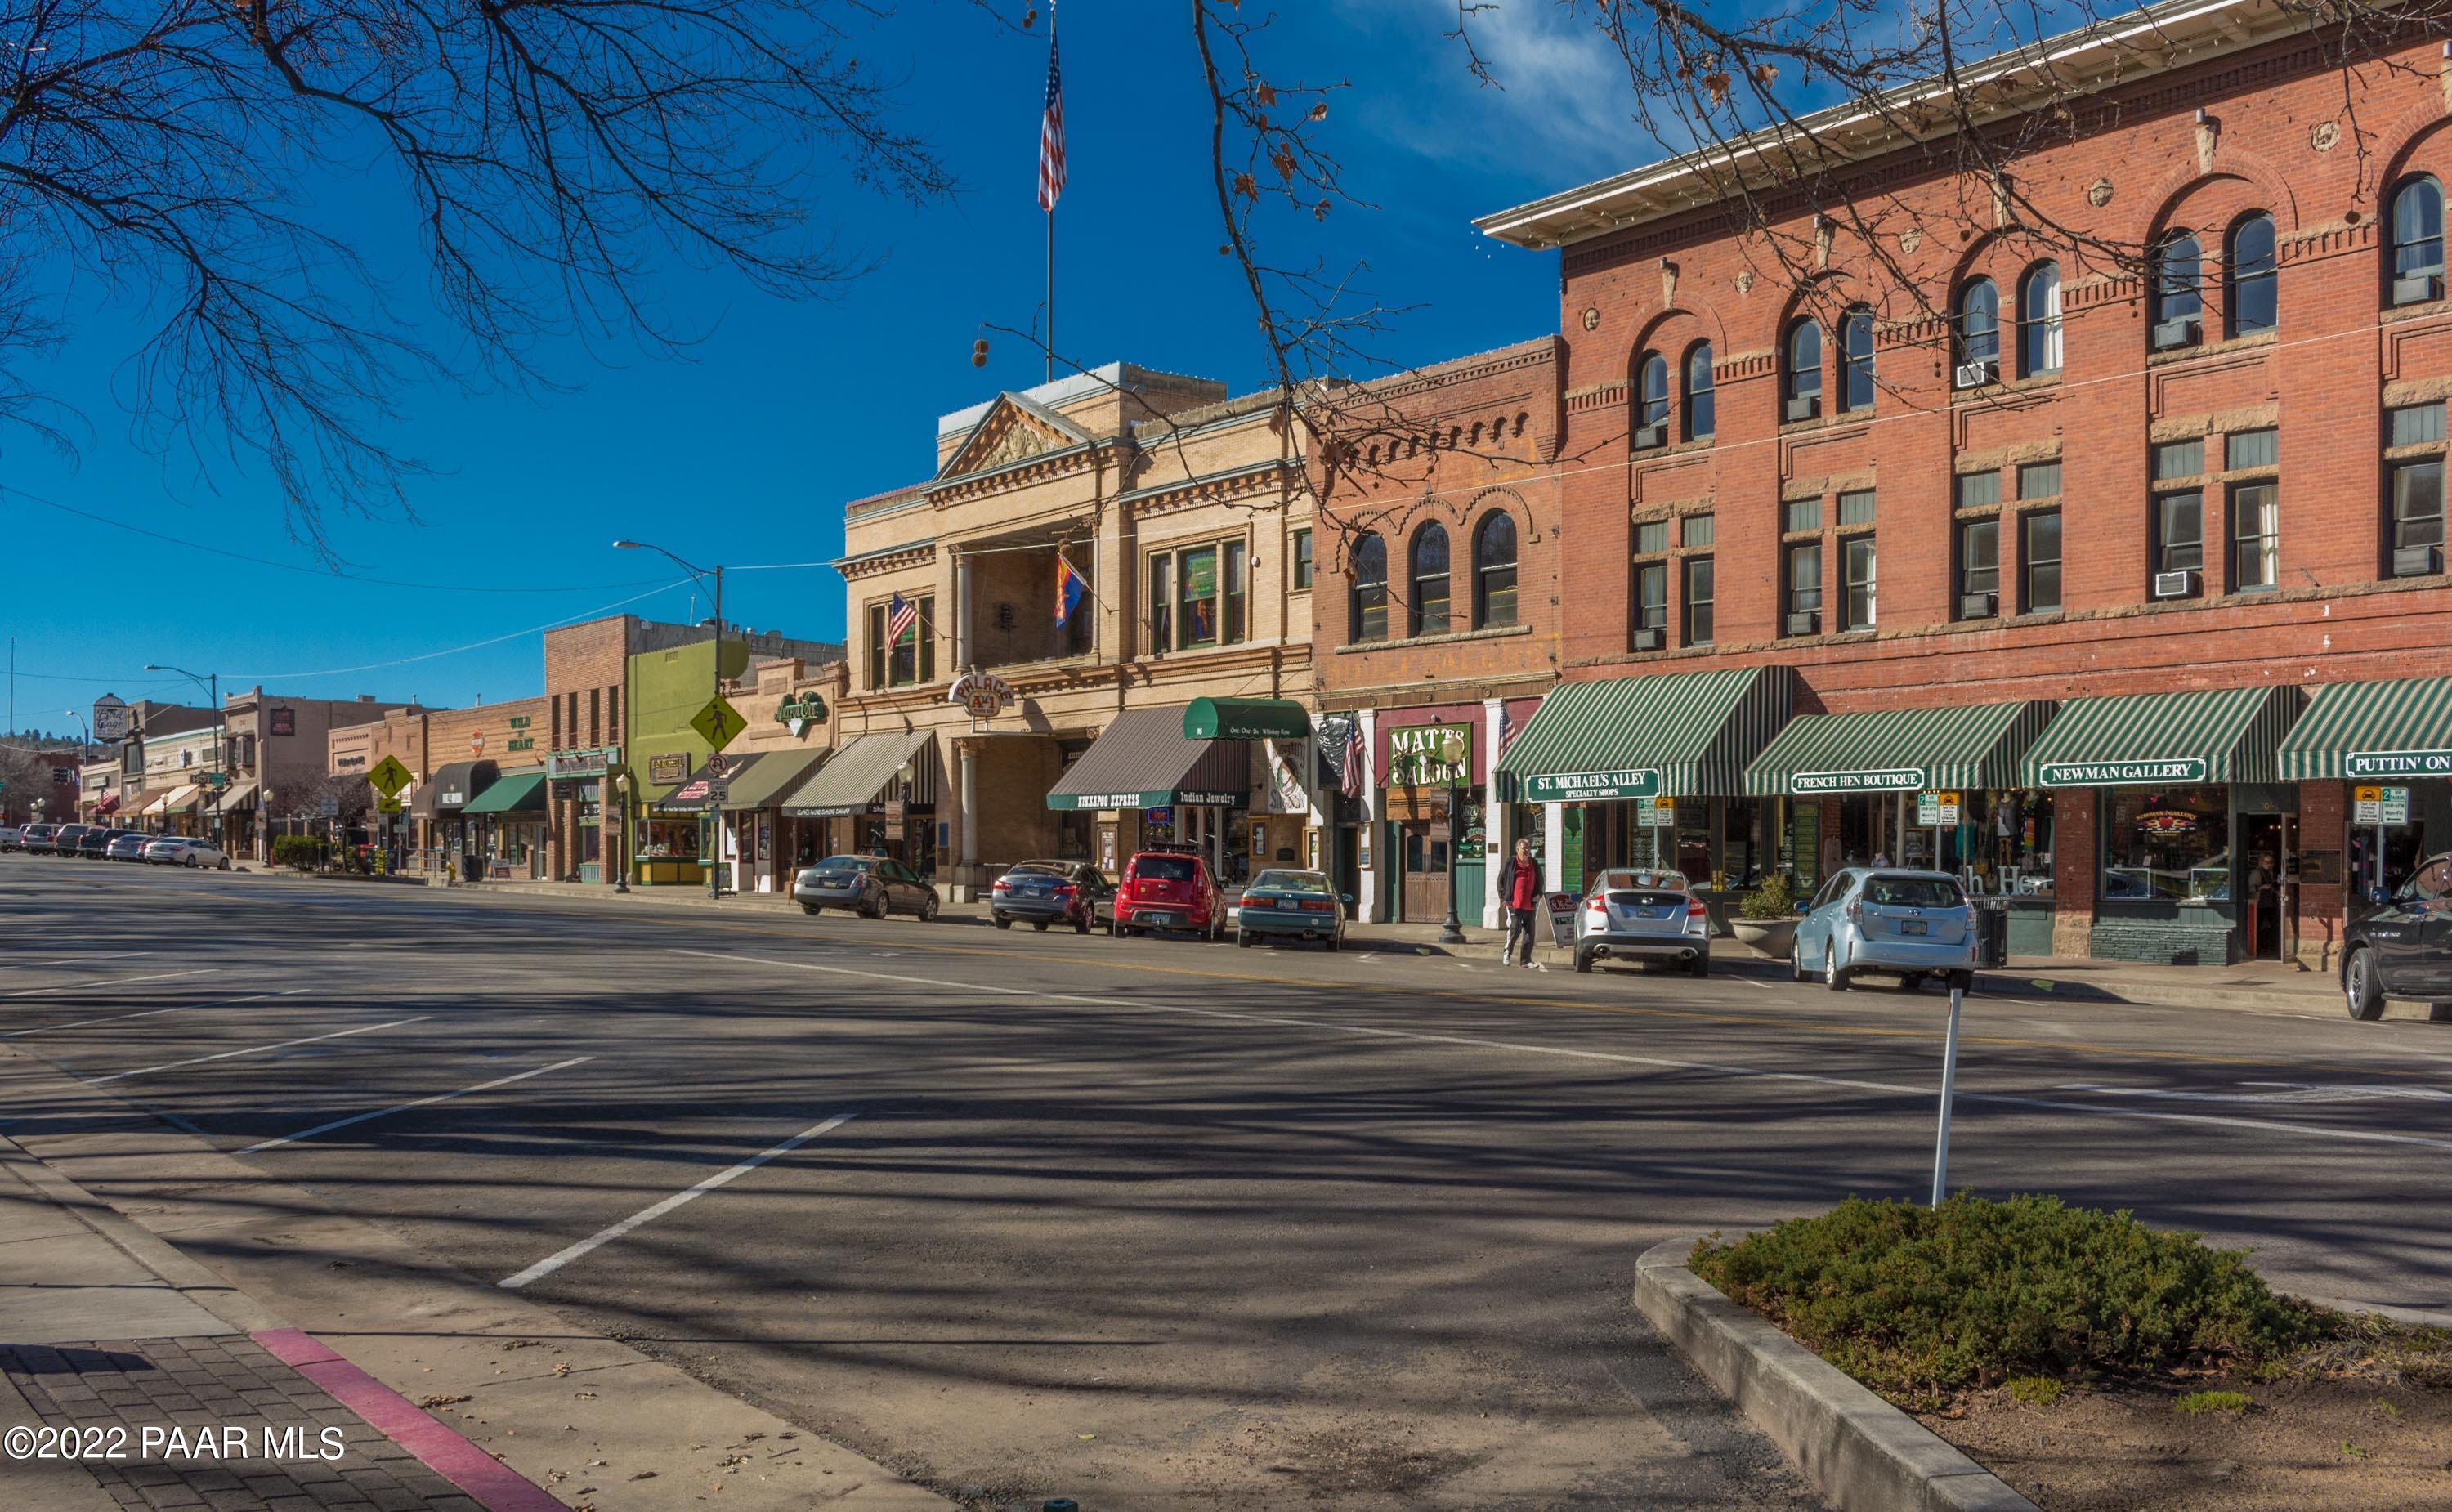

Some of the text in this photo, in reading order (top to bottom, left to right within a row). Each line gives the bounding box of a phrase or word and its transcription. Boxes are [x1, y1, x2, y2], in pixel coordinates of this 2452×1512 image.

[955, 676, 1013, 701] PALACE
[508, 737, 535, 752] HEART
[1392, 756, 1468, 785] SALOON
[2356, 756, 2450, 772] PUTTIN' ON
[2052, 763, 2192, 781] NEWMAN GALLERY
[1537, 772, 1645, 790] ST. MICHAEL'S ALLEY
[1798, 773, 1917, 789] FRENCH HEN BOUTIQUE
[710, 790, 726, 801] 25
[1111, 794, 1139, 807] EXPRESS
[1180, 791, 1236, 805] Indian Jewelry
[1565, 788, 1618, 798] SPECIALTY SHOPS
[2384, 790, 2389, 800] 2
